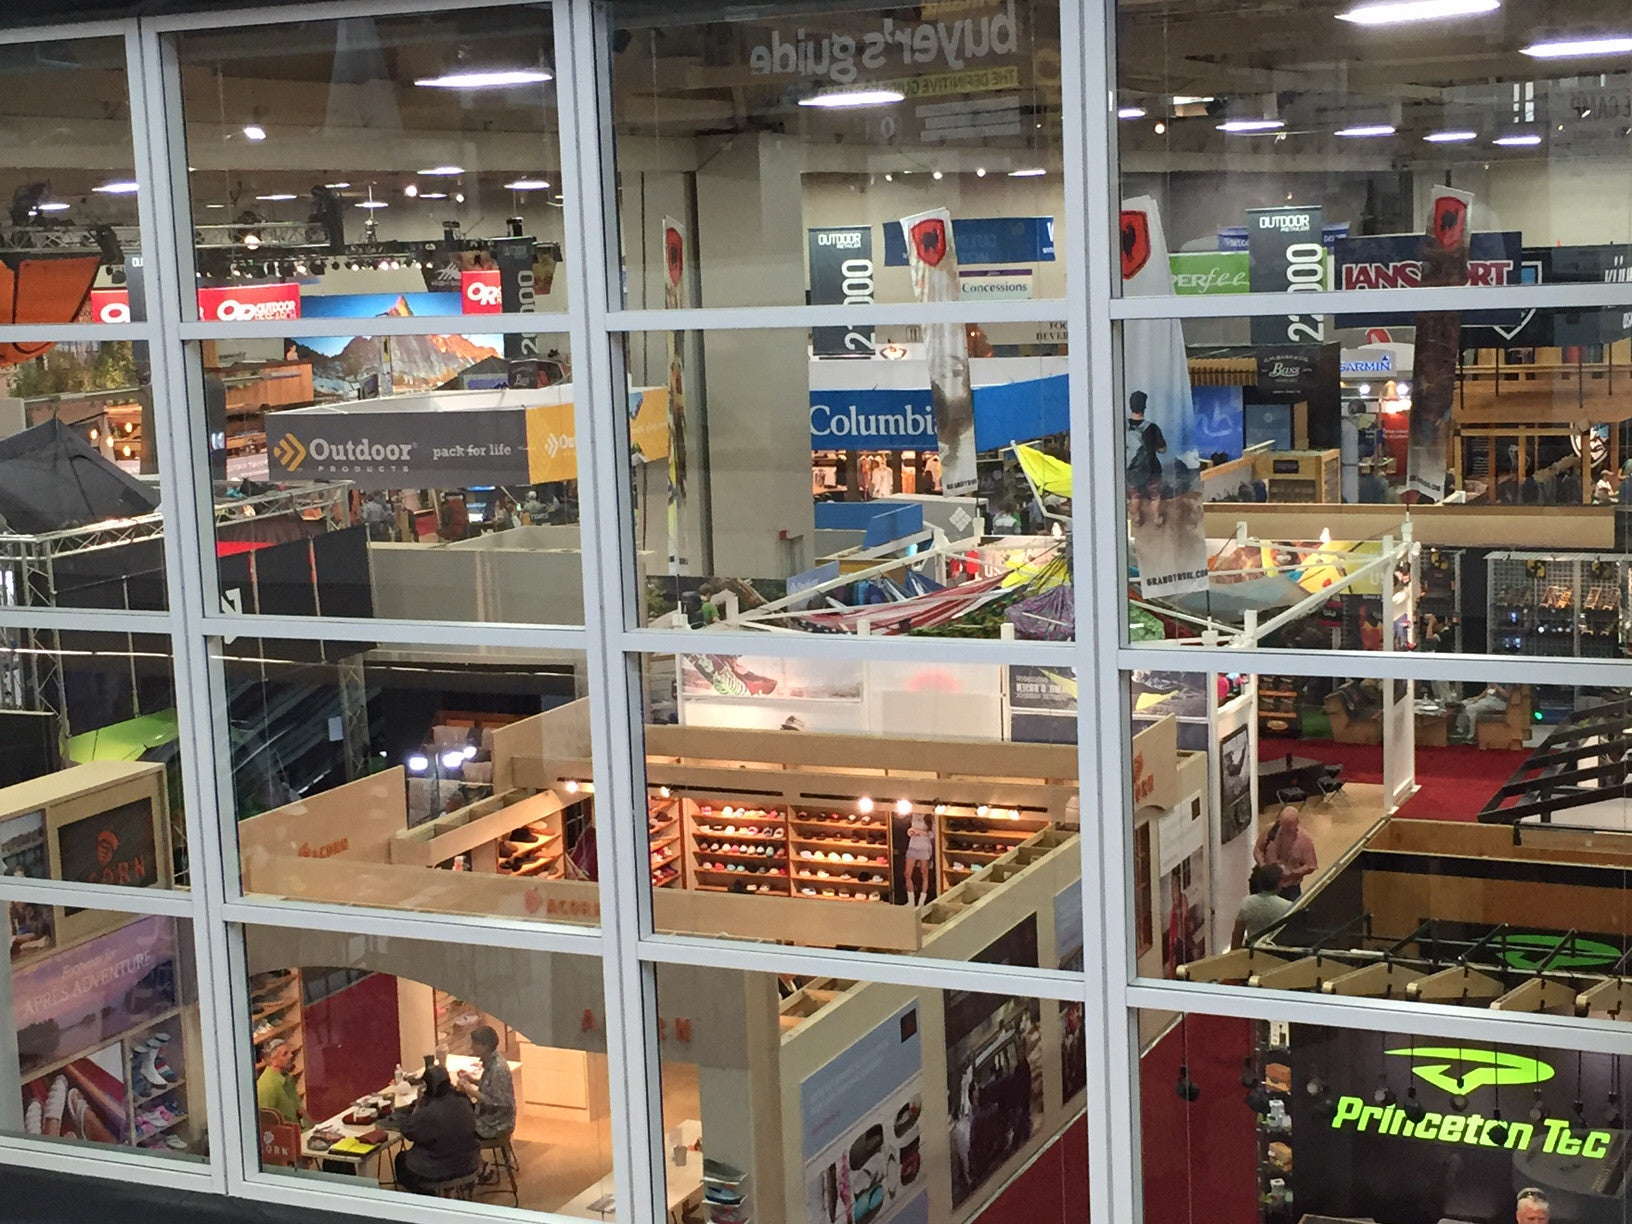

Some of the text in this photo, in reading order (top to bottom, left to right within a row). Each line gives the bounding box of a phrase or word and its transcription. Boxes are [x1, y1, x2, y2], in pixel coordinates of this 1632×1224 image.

[1259, 214, 1310, 229] OUTDOOR
[818, 232, 861, 246] OUTDOOR
[962, 281, 1028, 293] Concessions
[810, 404, 938, 437] Columbi
[309, 437, 412, 462] Outdoor
[433, 443, 512, 461] pack for life
[318, 465, 410, 473] PRODUCTS
[1331, 1095, 1611, 1159] Princeton Tec
